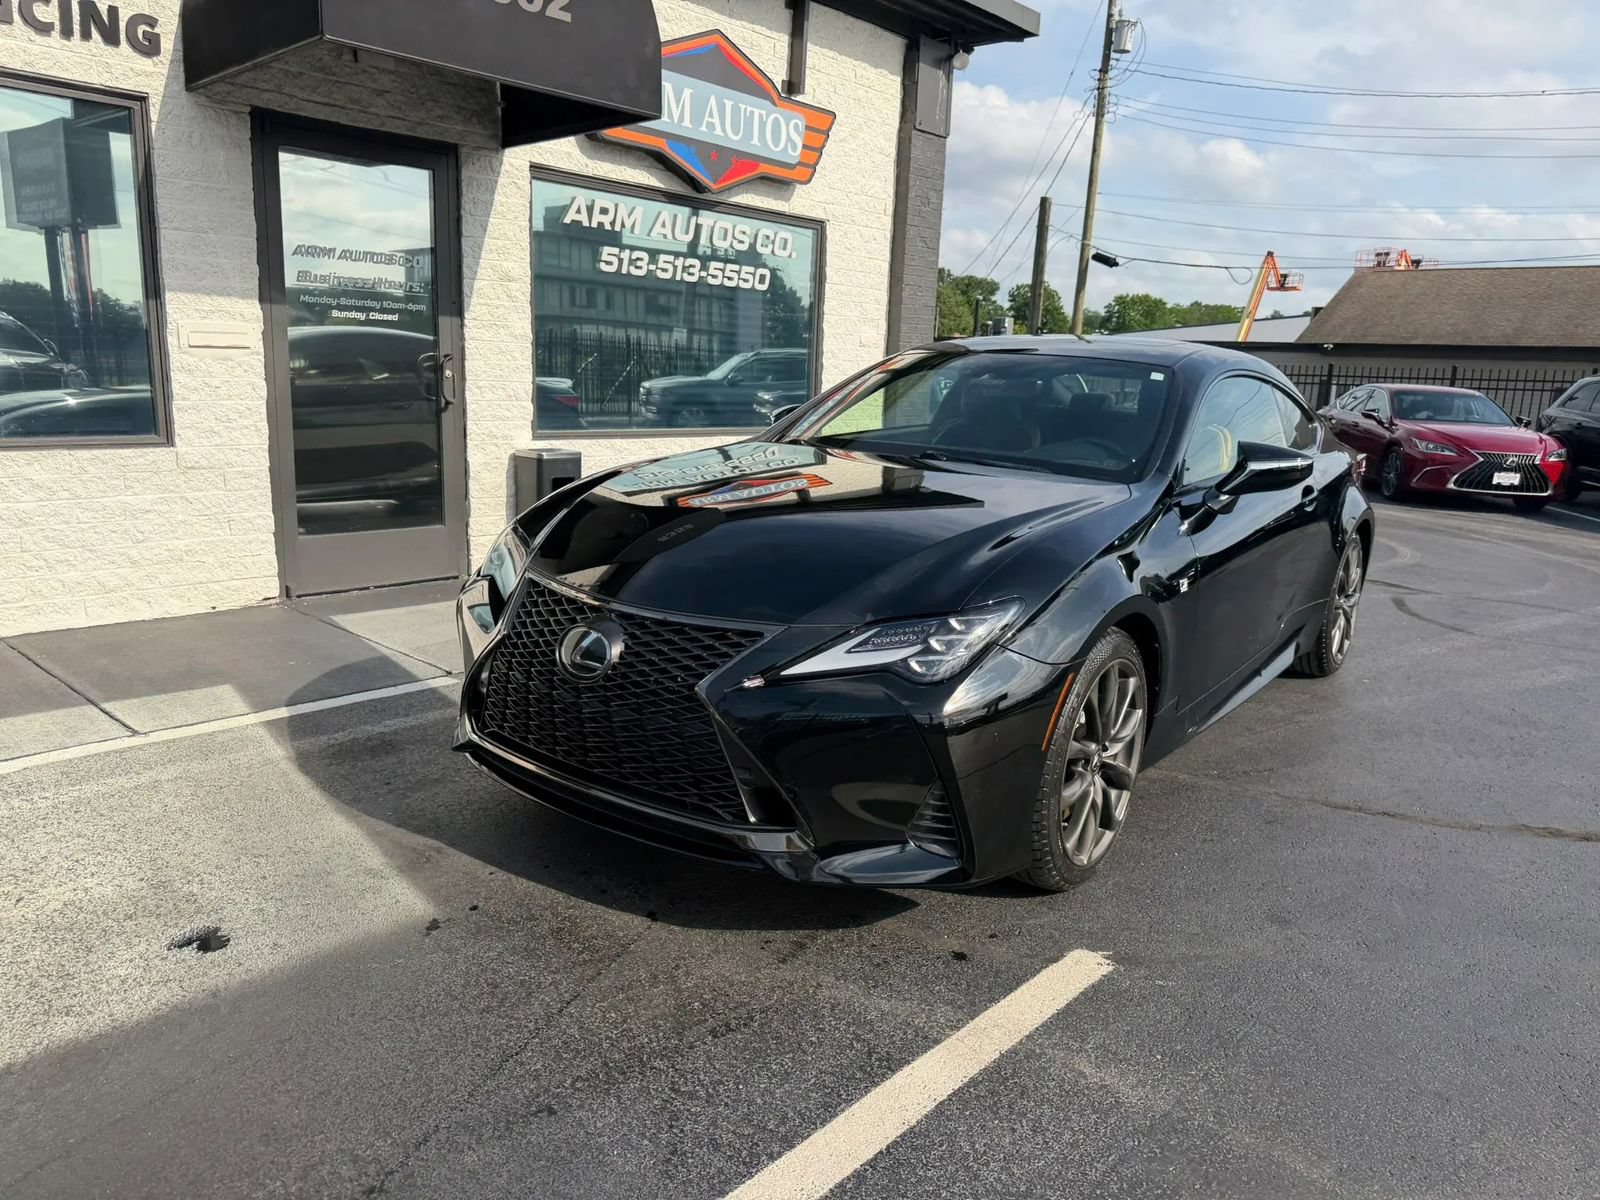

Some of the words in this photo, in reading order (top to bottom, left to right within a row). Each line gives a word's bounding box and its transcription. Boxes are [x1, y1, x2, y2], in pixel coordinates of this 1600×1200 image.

[0, 0, 162, 57] CING
[700, 95, 802, 156] AUTOS
[564, 195, 643, 234] ARM
[651, 211, 750, 251] AUTOS
[755, 227, 798, 259] CO.
[599, 246, 772, 291] 513-513-5550
[299, 294, 381, 309] Monday-Saturday
[382, 301, 427, 312] 10am-6pm
[331, 309, 366, 320] Sunday
[369, 311, 399, 321] Closed
